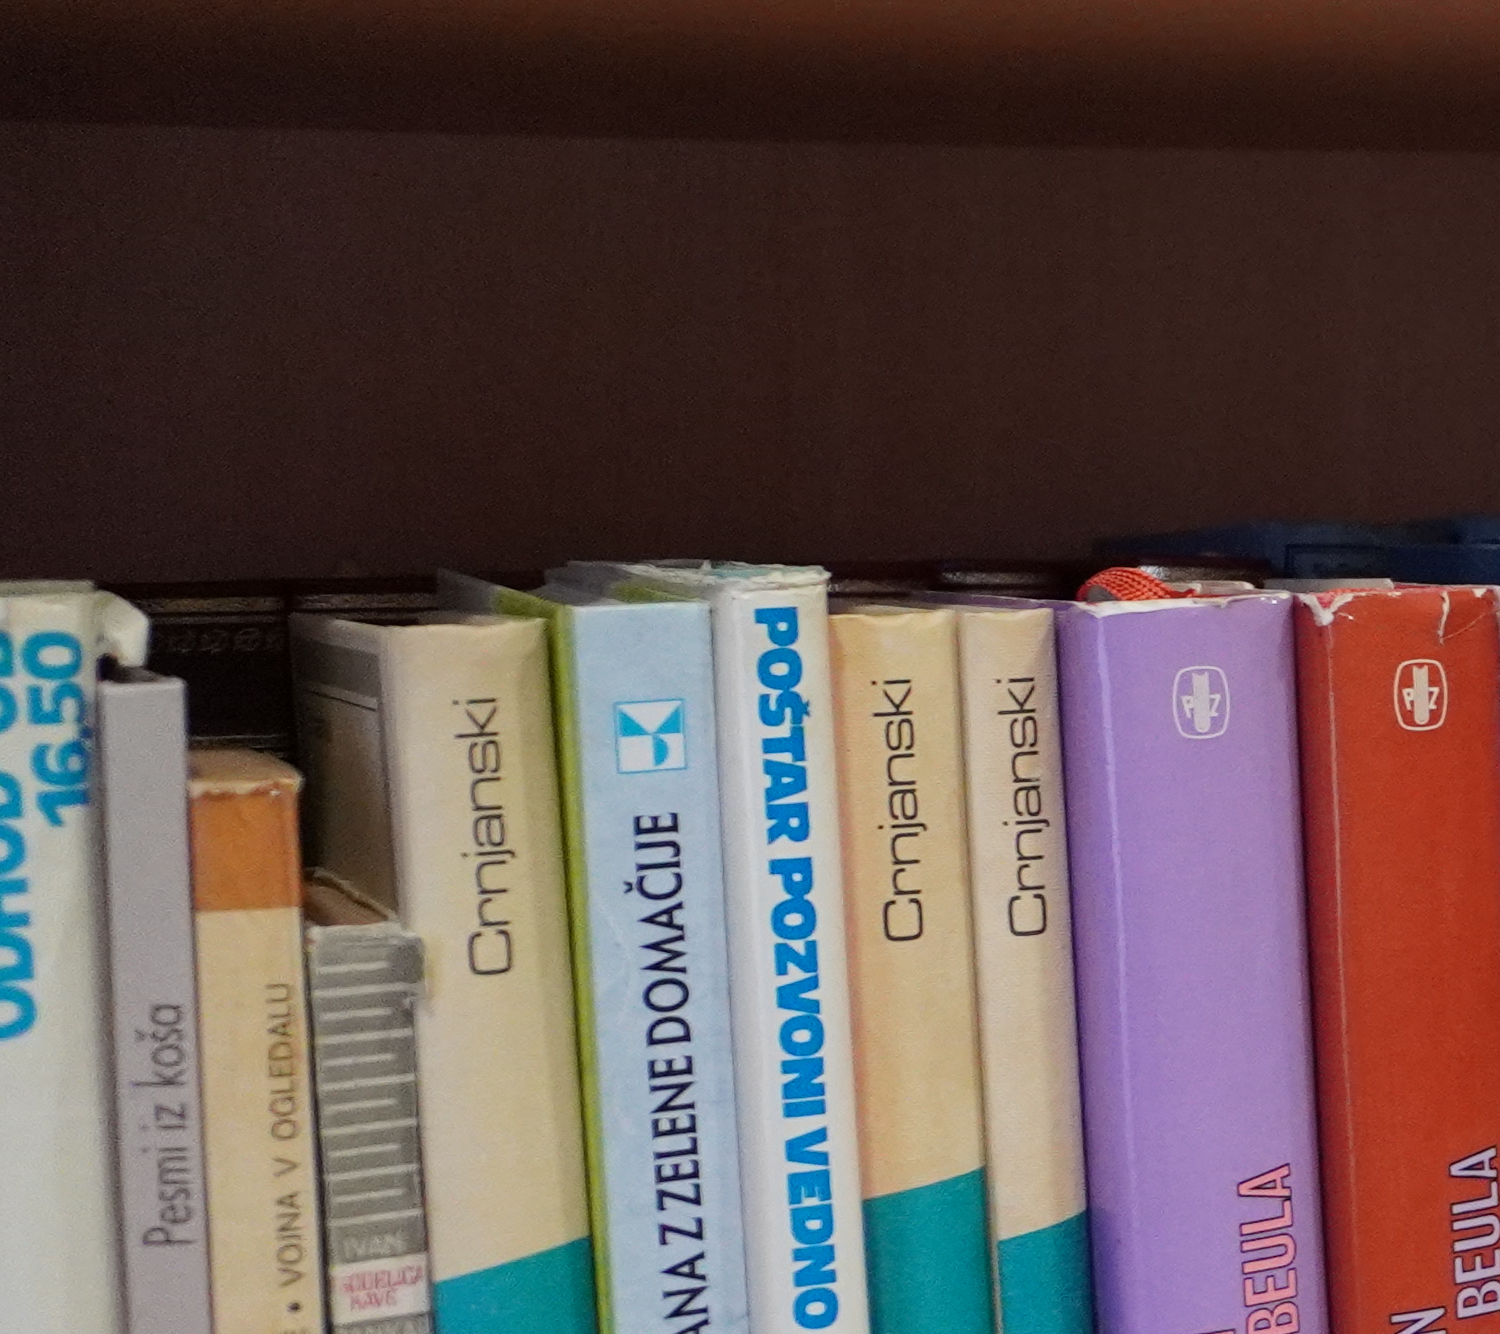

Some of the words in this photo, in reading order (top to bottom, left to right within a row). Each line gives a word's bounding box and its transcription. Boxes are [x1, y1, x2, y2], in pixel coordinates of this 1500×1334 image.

[20, 631, 94, 827] 16.50
[753, 605, 808, 848] POŠTAR
[873, 675, 928, 944] Crnjanski
[997, 675, 1051, 941] Crnjanski
[455, 696, 516, 979] Crnjanski
[624, 810, 693, 1047] DOMAČIJE
[138, 1000, 188, 1090] koša
[764, 857, 819, 1118] POZVONI
[141, 1141, 197, 1251] Pesmi
[143, 1096, 188, 1134] iz
[646, 1050, 701, 1209] ZELENE
[660, 1214, 704, 1247] Z
[780, 1127, 843, 1331] VEDNO
